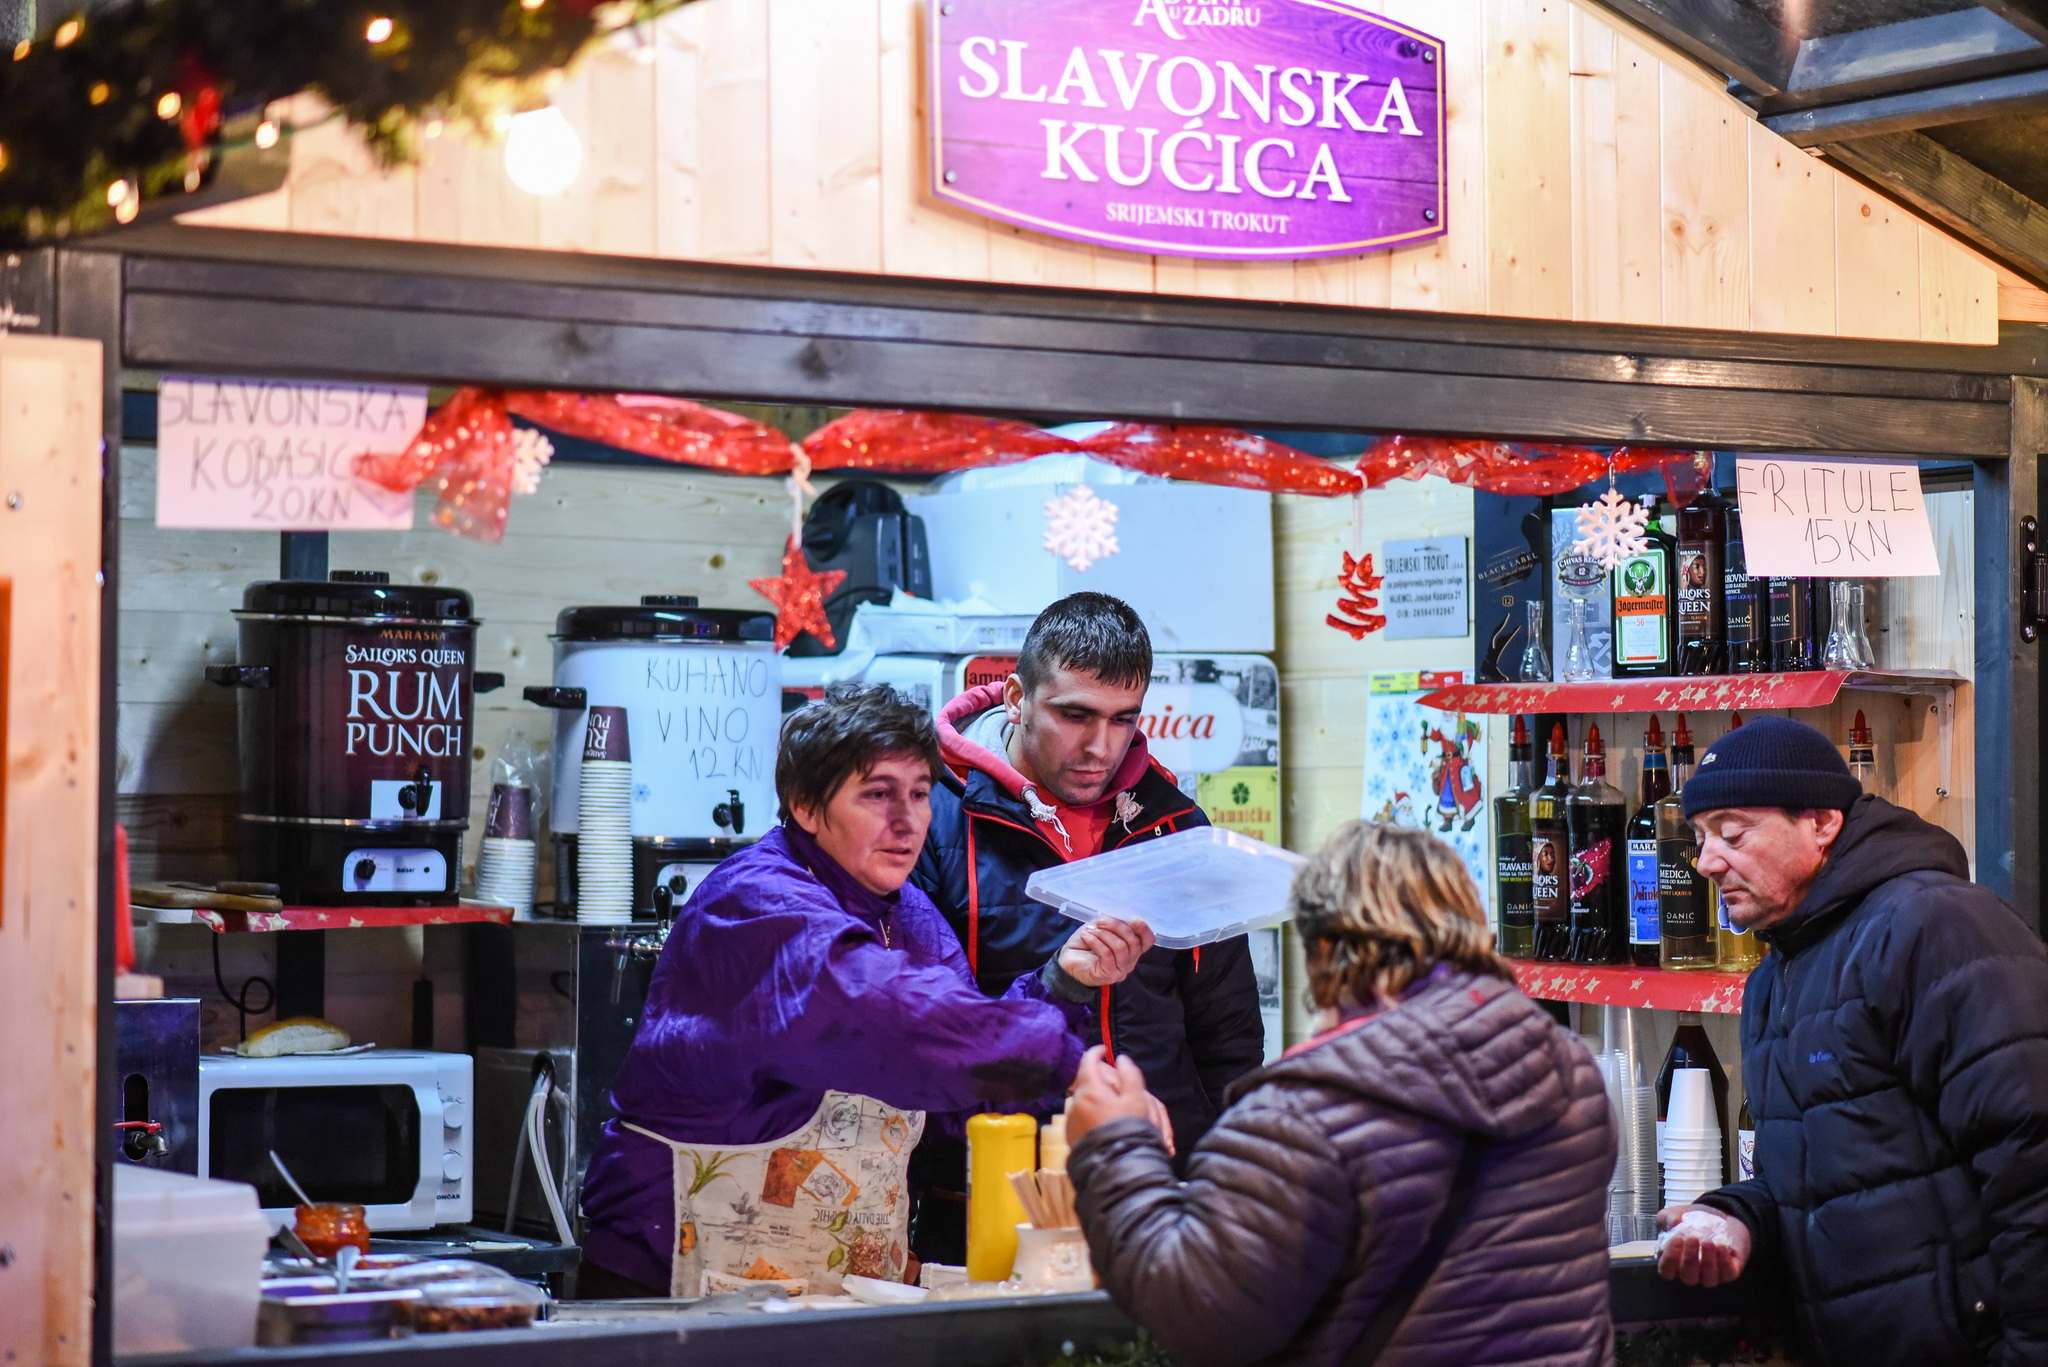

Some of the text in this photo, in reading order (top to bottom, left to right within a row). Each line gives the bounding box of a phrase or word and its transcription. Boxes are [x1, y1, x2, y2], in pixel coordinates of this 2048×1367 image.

[1183, 6, 1261, 27] ZADRU
[958, 35, 1424, 137] SLAVONSKA
[1040, 116, 1352, 203] KUĆICA
[1105, 202, 1290, 234] SRIJEMSKI TROKUT
[158, 378, 407, 433] SLAVONSKA
[1737, 463, 1915, 516] FRITULE
[1804, 517, 1893, 566] 15KN
[1385, 556, 1420, 574] SRIJEMSKI
[1423, 553, 1449, 572] TROKUT
[1477, 564, 1507, 580] BLACK
[1509, 552, 1538, 568] LABEL
[1558, 555, 1602, 568] CHIVAS REGA
[1578, 567, 1586, 575] 12
[1617, 599, 1664, 613] Jägermeister
[380, 629, 447, 641] MARASKA
[1636, 617, 1645, 627] 56
[345, 644, 465, 668] SAILOR'S QUEEN
[647, 655, 768, 699] KUHANO
[346, 669, 463, 720] RUM
[657, 706, 749, 743] VINO
[345, 722, 463, 757] PUNCH
[1659, 869, 1691, 879] MEDICA
[813, 1208, 853, 1224] GPHIC
[876, 1212, 890, 1225] THE
